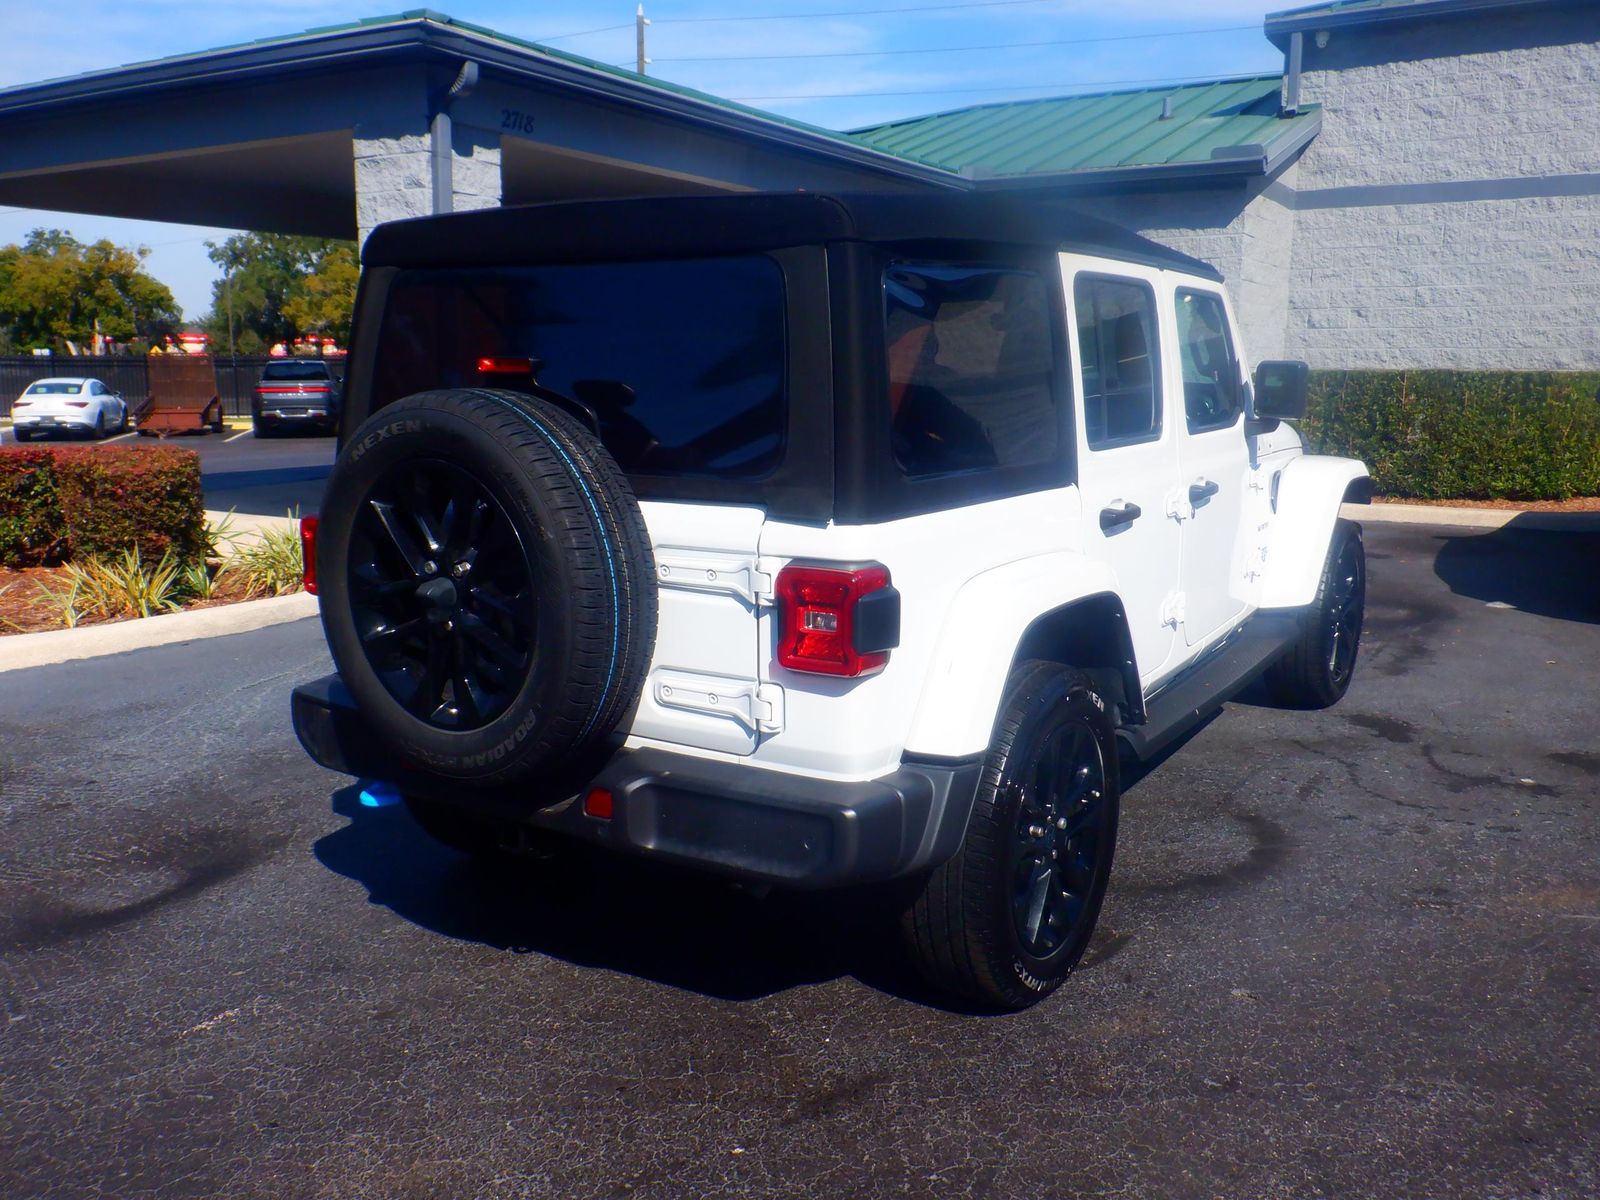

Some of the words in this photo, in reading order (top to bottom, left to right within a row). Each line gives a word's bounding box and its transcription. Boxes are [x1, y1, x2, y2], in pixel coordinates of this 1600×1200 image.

[501, 109, 535, 134] 2718
[351, 419, 422, 462] NEXEN
[461, 708, 537, 768] ROADIAN
